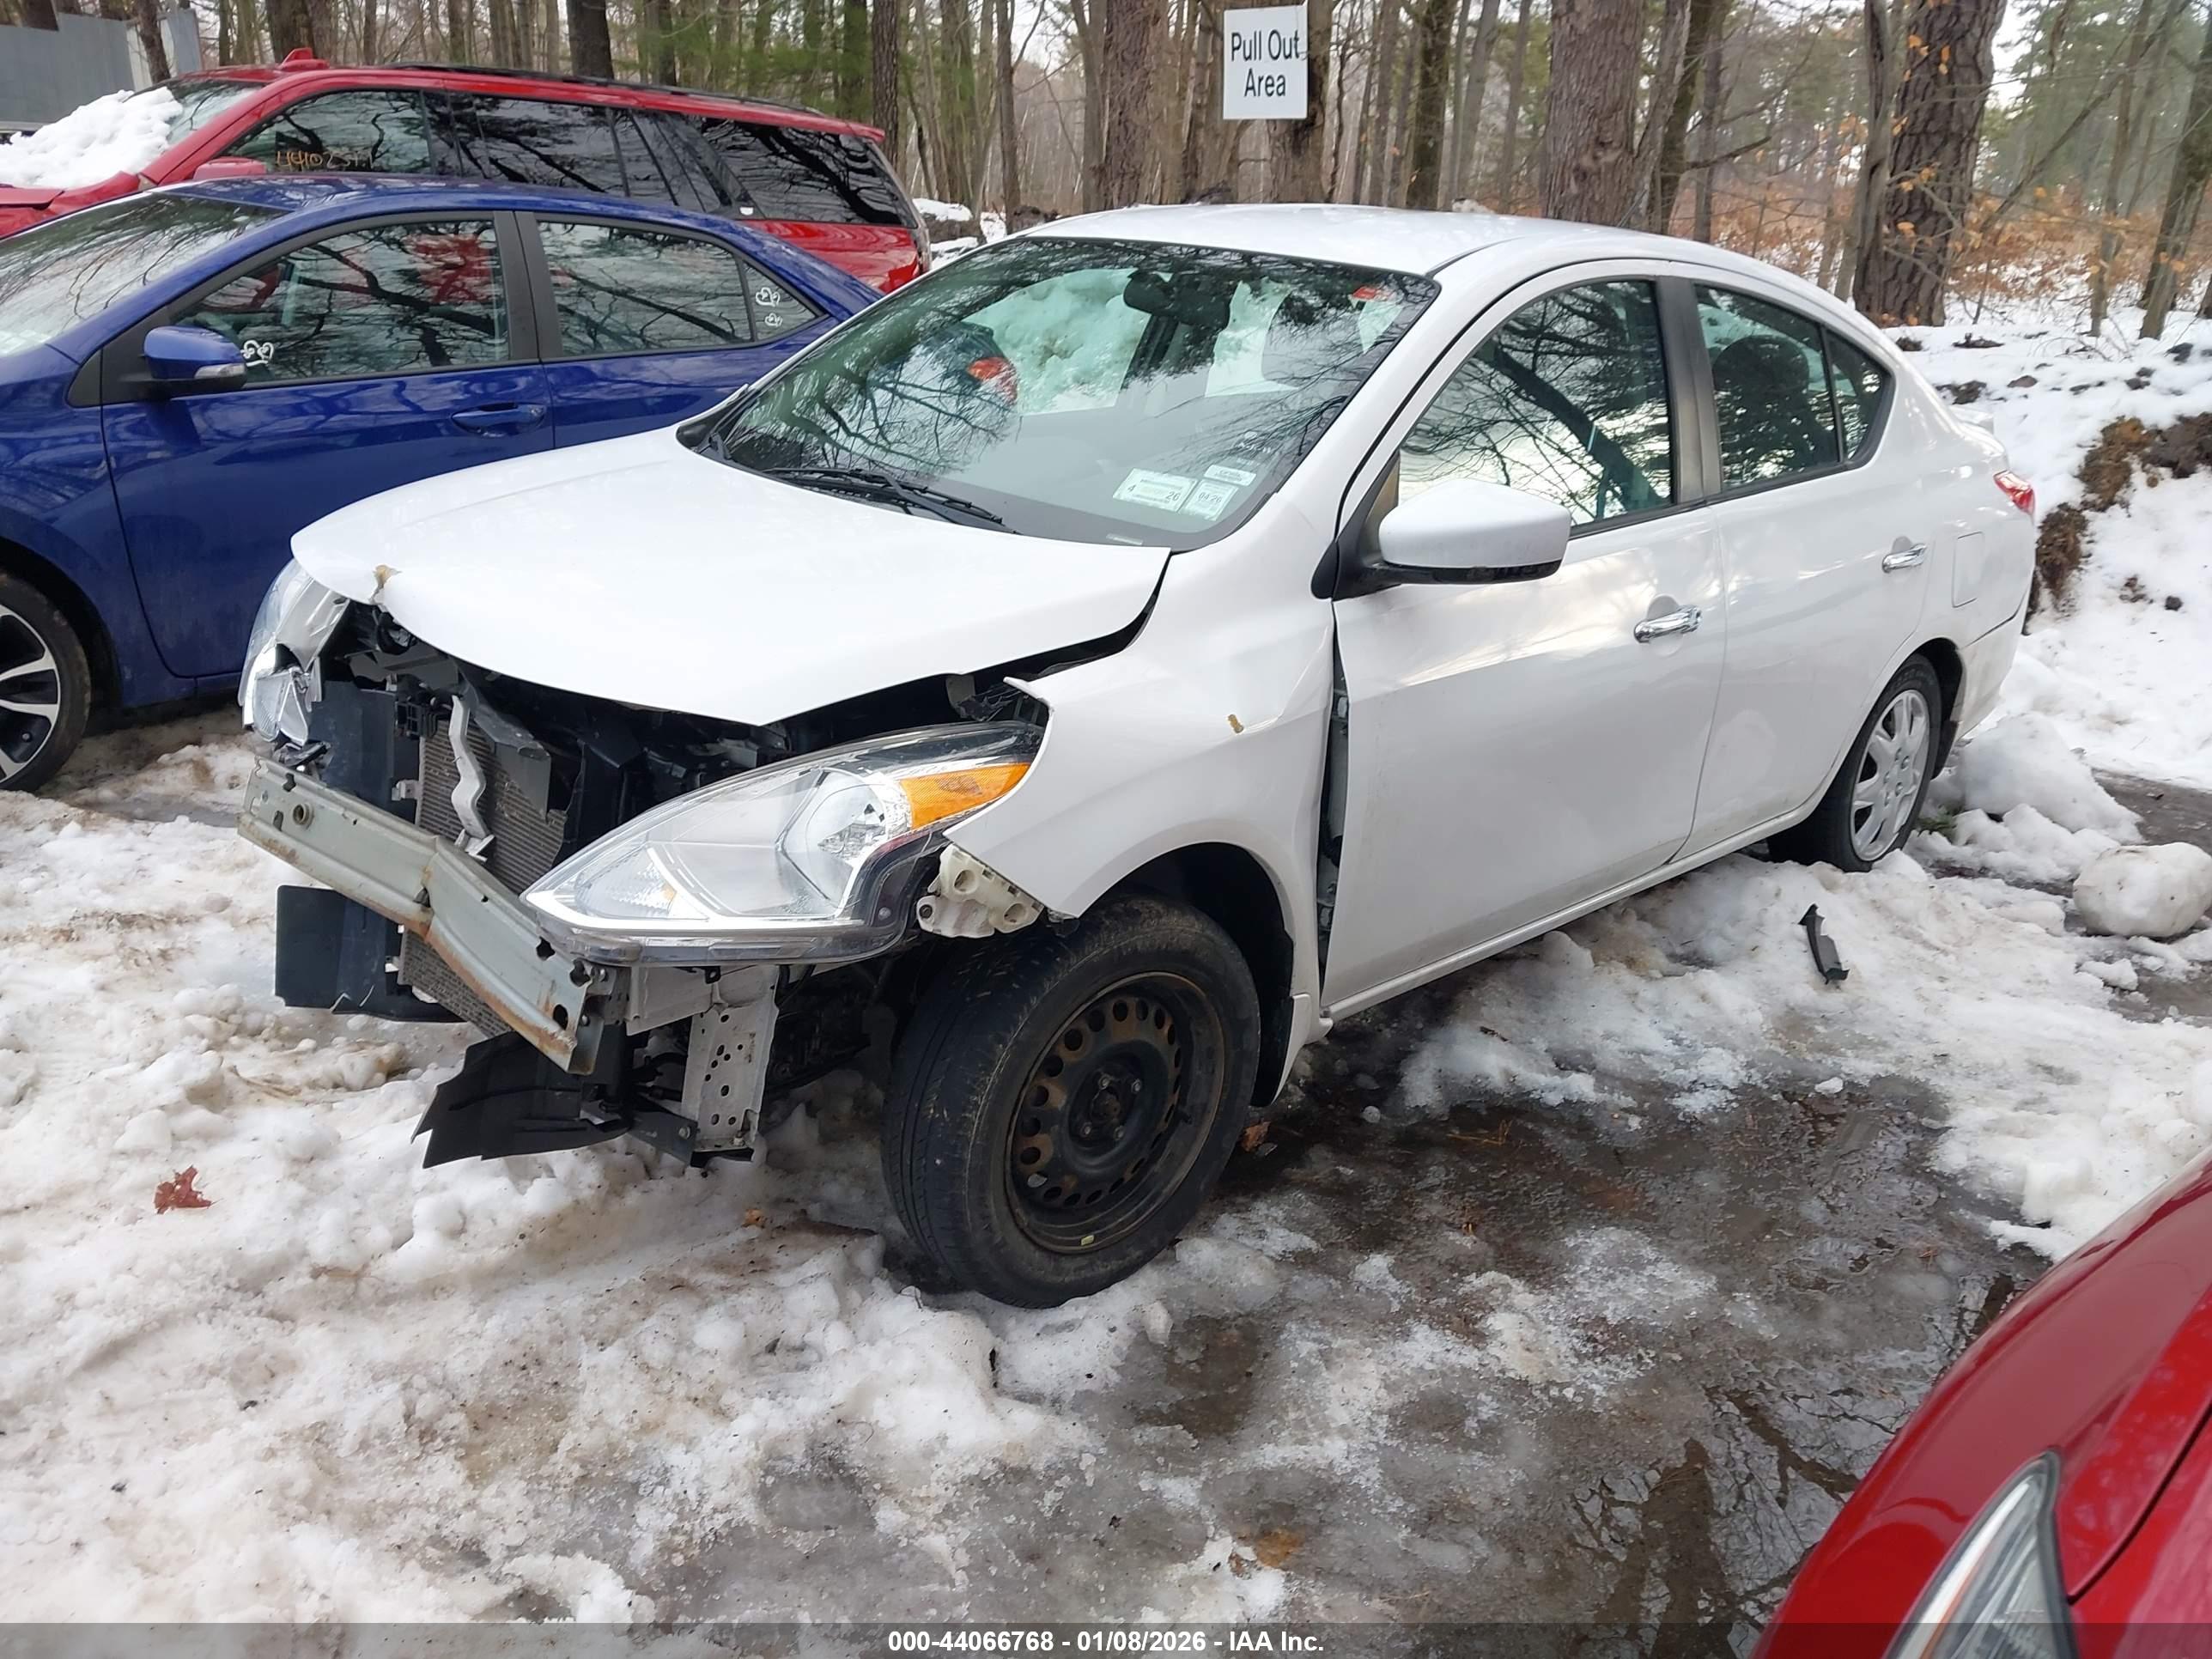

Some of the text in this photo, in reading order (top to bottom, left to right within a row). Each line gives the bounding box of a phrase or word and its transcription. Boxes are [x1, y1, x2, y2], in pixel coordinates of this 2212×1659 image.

[1231, 28, 1300, 62] Pull Out
[1243, 67, 1286, 98] Area
[1165, 490, 1181, 501] 26
